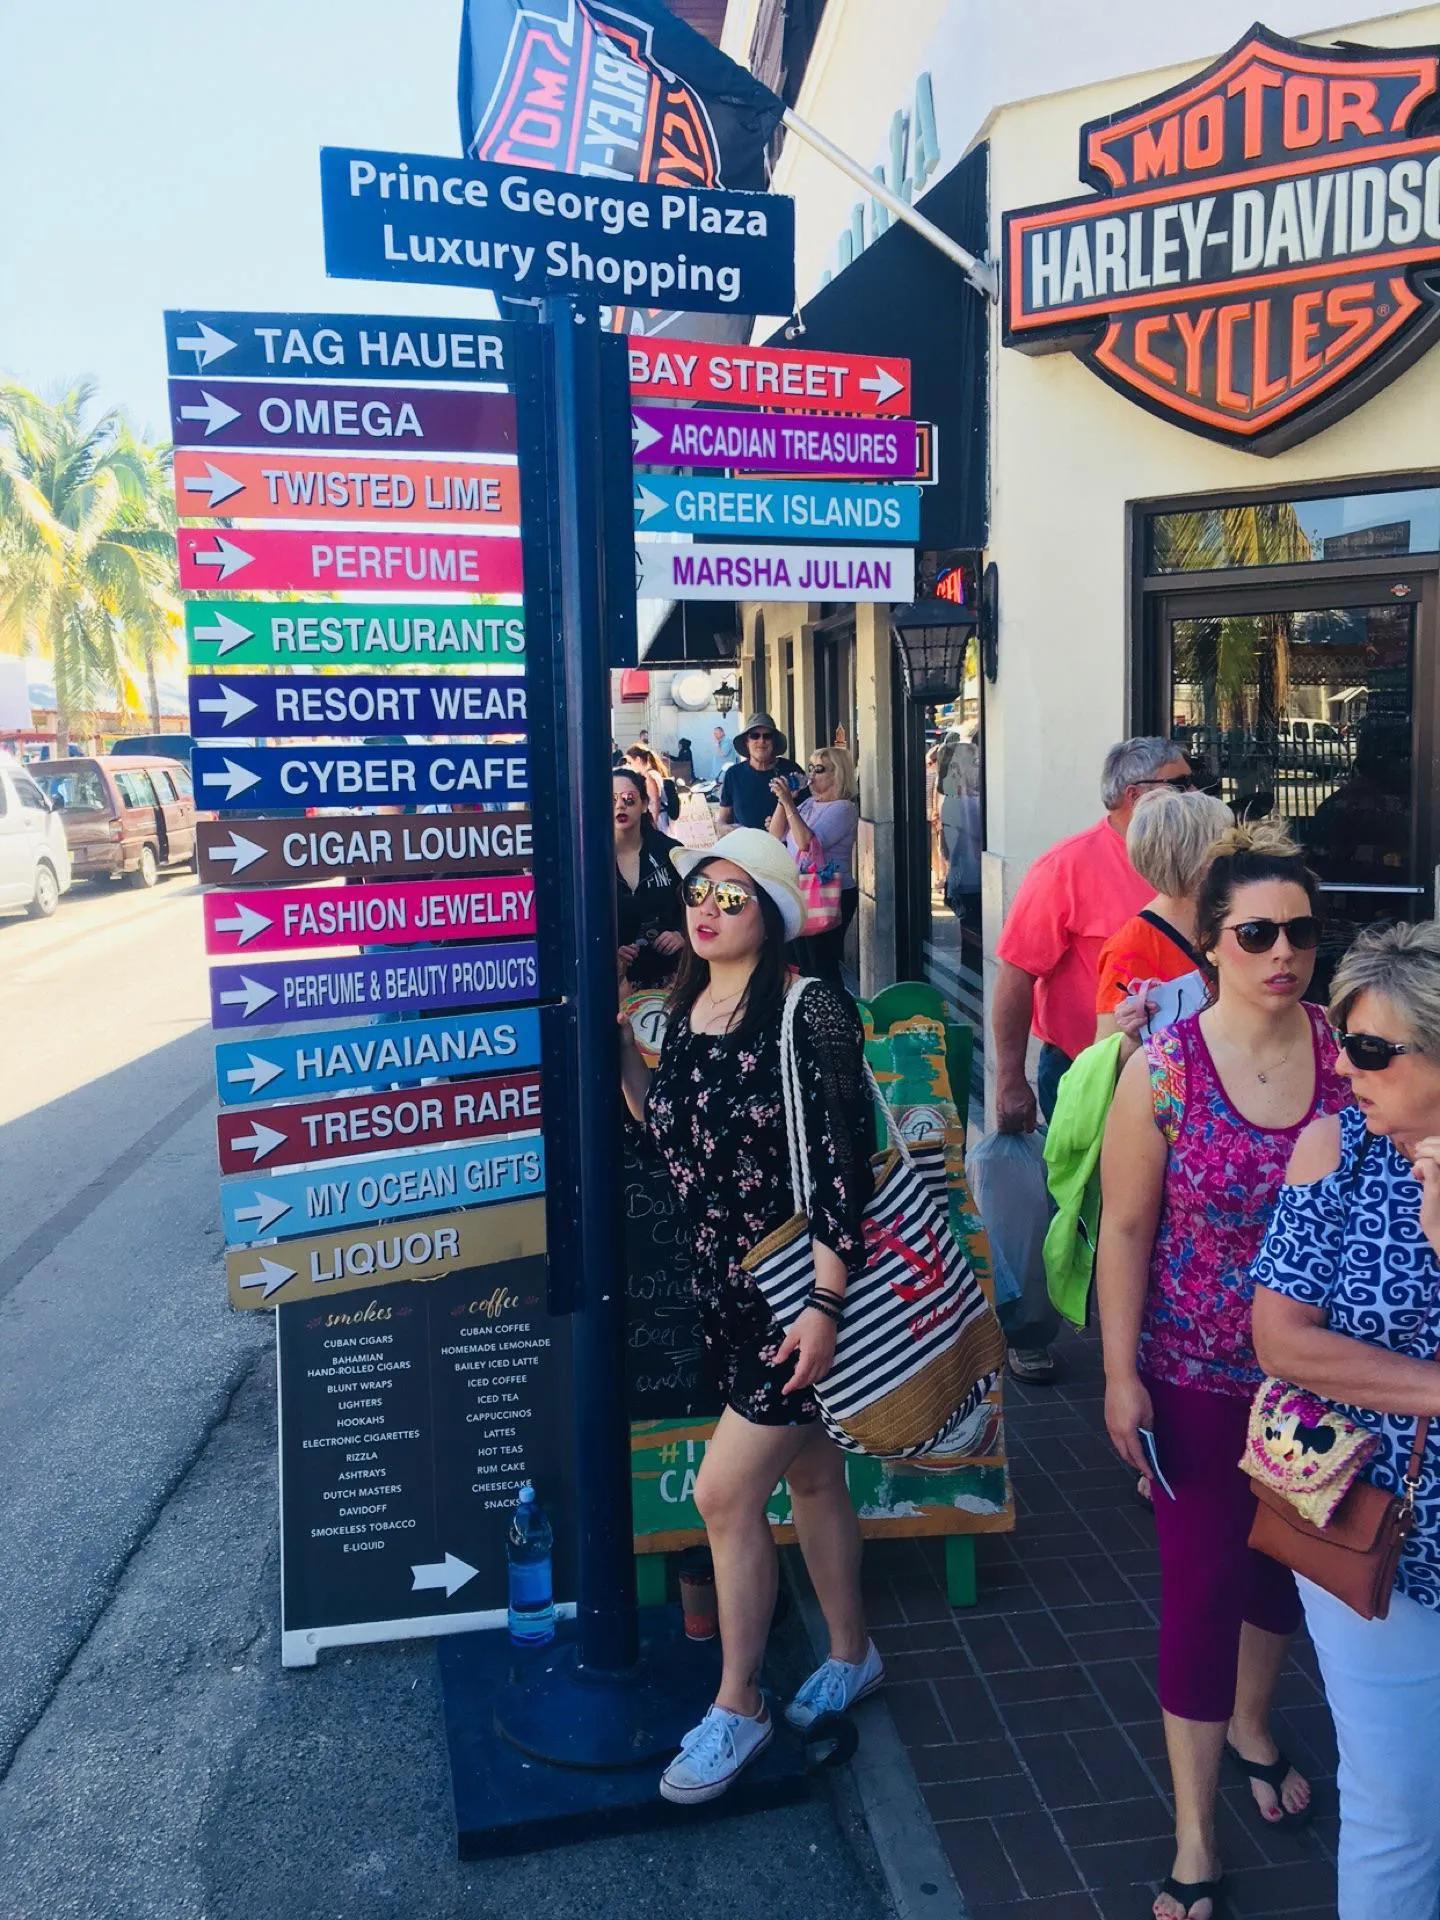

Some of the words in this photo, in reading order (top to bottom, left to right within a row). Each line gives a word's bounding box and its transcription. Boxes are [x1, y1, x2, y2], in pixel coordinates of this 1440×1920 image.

[1132, 62, 1385, 185] MOTOR
[349, 159, 489, 208] Prince
[500, 173, 650, 234] George
[662, 195, 768, 237] Plaza
[383, 224, 535, 280] Luxury
[546, 241, 742, 302] Shopping
[254, 328, 346, 366] TAG
[360, 331, 504, 371] HAUER
[1134, 282, 1377, 412] CYCLES
[628, 350, 699, 386] BAY
[709, 358, 850, 398] STREET
[257, 398, 425, 438] OMEGA
[670, 423, 777, 459] ARCADIAN
[782, 428, 898, 464] TREASURES
[263, 470, 415, 510] TWISTED
[426, 476, 502, 512] LIME
[675, 490, 774, 524] GREEK
[783, 494, 901, 528] ISLANDS
[311, 544, 480, 583] PERFUME
[672, 556, 791, 587] MARSHA
[799, 560, 892, 589] JULIAN
[270, 617, 526, 653] RESTAURANTS
[276, 688, 421, 722] RESORT
[429, 687, 528, 721] WEAR
[280, 760, 416, 795] CYBER
[428, 758, 528, 791] CAFE
[282, 830, 393, 868] CIGAR
[402, 824, 534, 861] LOUNGE
[283, 897, 407, 936] FASHION
[414, 890, 535, 928] JEWELRY
[283, 972, 366, 1009] PERFUME
[370, 976, 381, 1000] &
[386, 963, 449, 999] BEAUTY
[452, 956, 537, 993] PRODUCTS
[296, 1024, 518, 1081] HAVAIANAS
[302, 1098, 444, 1147] TRESOR
[455, 1085, 542, 1126] RARE
[306, 1181, 350, 1218] MY
[357, 1164, 457, 1208] OCEAN
[463, 1150, 541, 1191] GIFTS
[310, 1227, 460, 1282] LIQUOR
[325, 1300, 392, 1327] smokes
[469, 1287, 519, 1318] coffee
[323, 1338, 357, 1348] CUBAN
[359, 1335, 393, 1345] CIGARS
[460, 1326, 492, 1336] CUBAN
[495, 1323, 531, 1333] COFFEE
[332, 1353, 384, 1365] BAHAMIAN
[441, 1343, 496, 1355] HOMEMADE
[499, 1339, 551, 1351] LEMONADE
[307, 1364, 375, 1377] HAND-ROLLED
[377, 1361, 412, 1371] CIGARS
[454, 1361, 486, 1371] BAILEY
[488, 1359, 510, 1368] ICED
[512, 1356, 539, 1367] LATTE
[327, 1383, 358, 1393] BLUNT
[360, 1380, 393, 1390] WRAPS
[468, 1378, 489, 1388] ICED
[492, 1375, 527, 1385] COFFEE
[338, 1398, 383, 1410] LIGHTERS
[477, 1395, 499, 1404] ICED
[502, 1393, 519, 1402] TEA
[337, 1416, 385, 1427] HOOKAHS
[466, 1409, 532, 1423] CAPPUCCINOS
[302, 1435, 361, 1448] ELECTRONIC
[363, 1430, 420, 1442] CIGARETTES
[484, 1428, 516, 1439] LATTES
[346, 1452, 378, 1462] RIZZLA
[478, 1447, 497, 1457] HOT
[500, 1445, 524, 1455] TEAS
[338, 1468, 386, 1480] ASHTRAYS
[477, 1465, 498, 1475] RUM
[500, 1462, 526, 1473] CAKE
[323, 1490, 356, 1500] DUTCH
[359, 1485, 402, 1497] MASTERS
[339, 1504, 387, 1516] DAVIDOFF
[311, 1525, 367, 1537] SMOKELESS
[370, 1520, 416, 1532] TOBACCO
[343, 1541, 385, 1553] E-LIQUID
